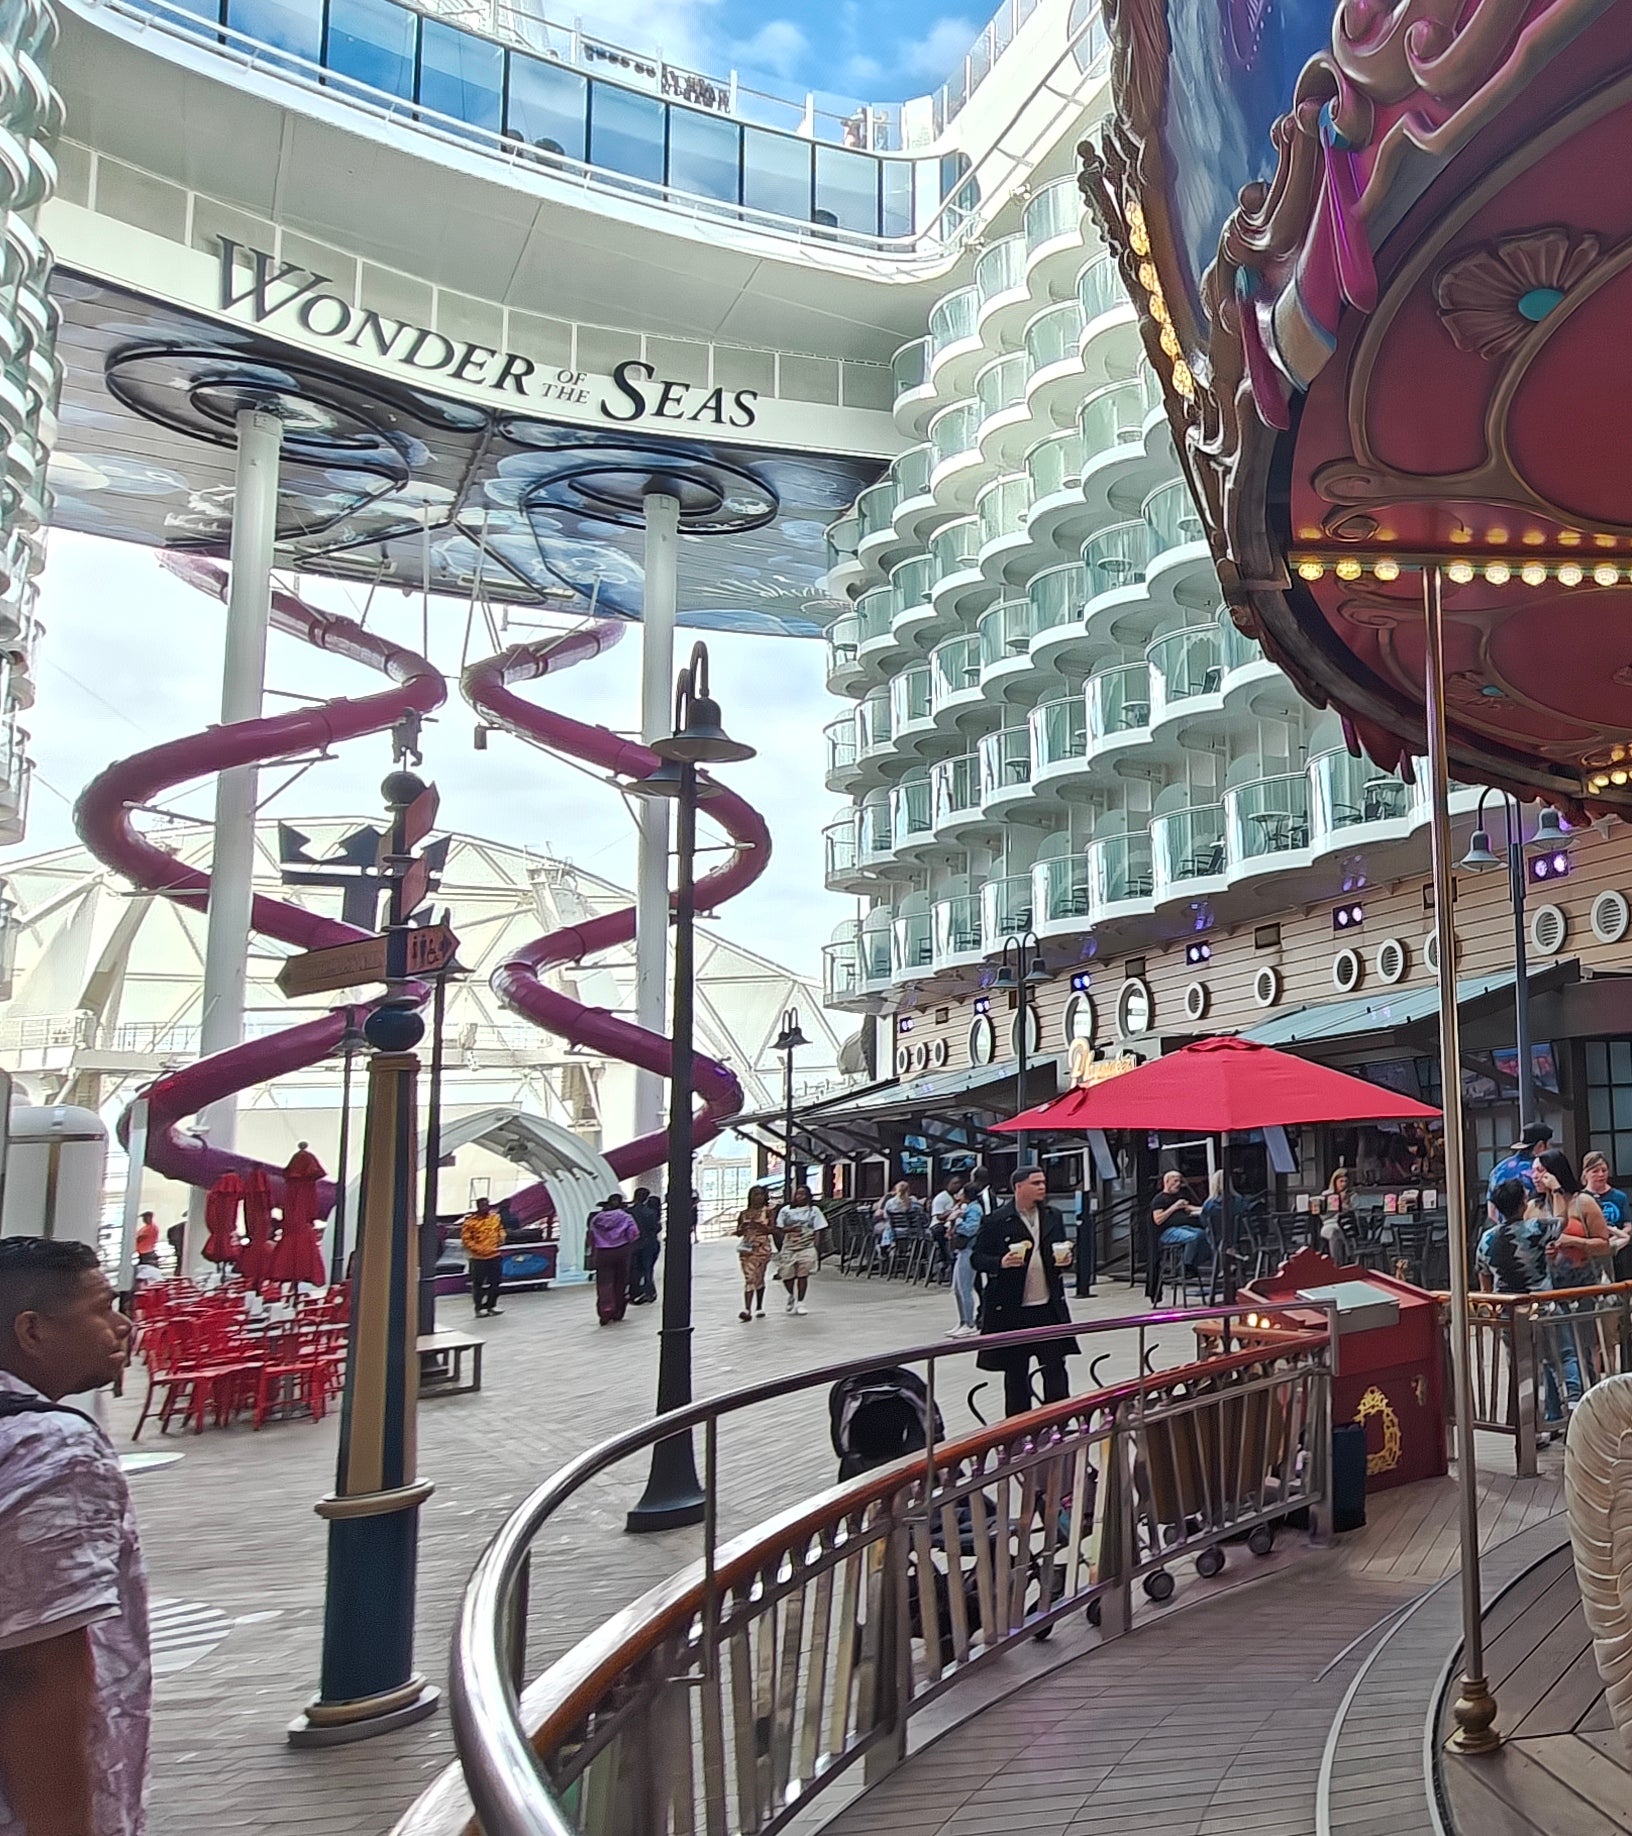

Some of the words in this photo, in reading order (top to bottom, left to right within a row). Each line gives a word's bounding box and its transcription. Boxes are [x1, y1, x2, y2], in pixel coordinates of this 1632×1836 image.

[215, 233, 536, 397] WONDER
[541, 382, 590, 404] THE
[556, 368, 588, 385] OF
[600, 359, 759, 428] SEAS
